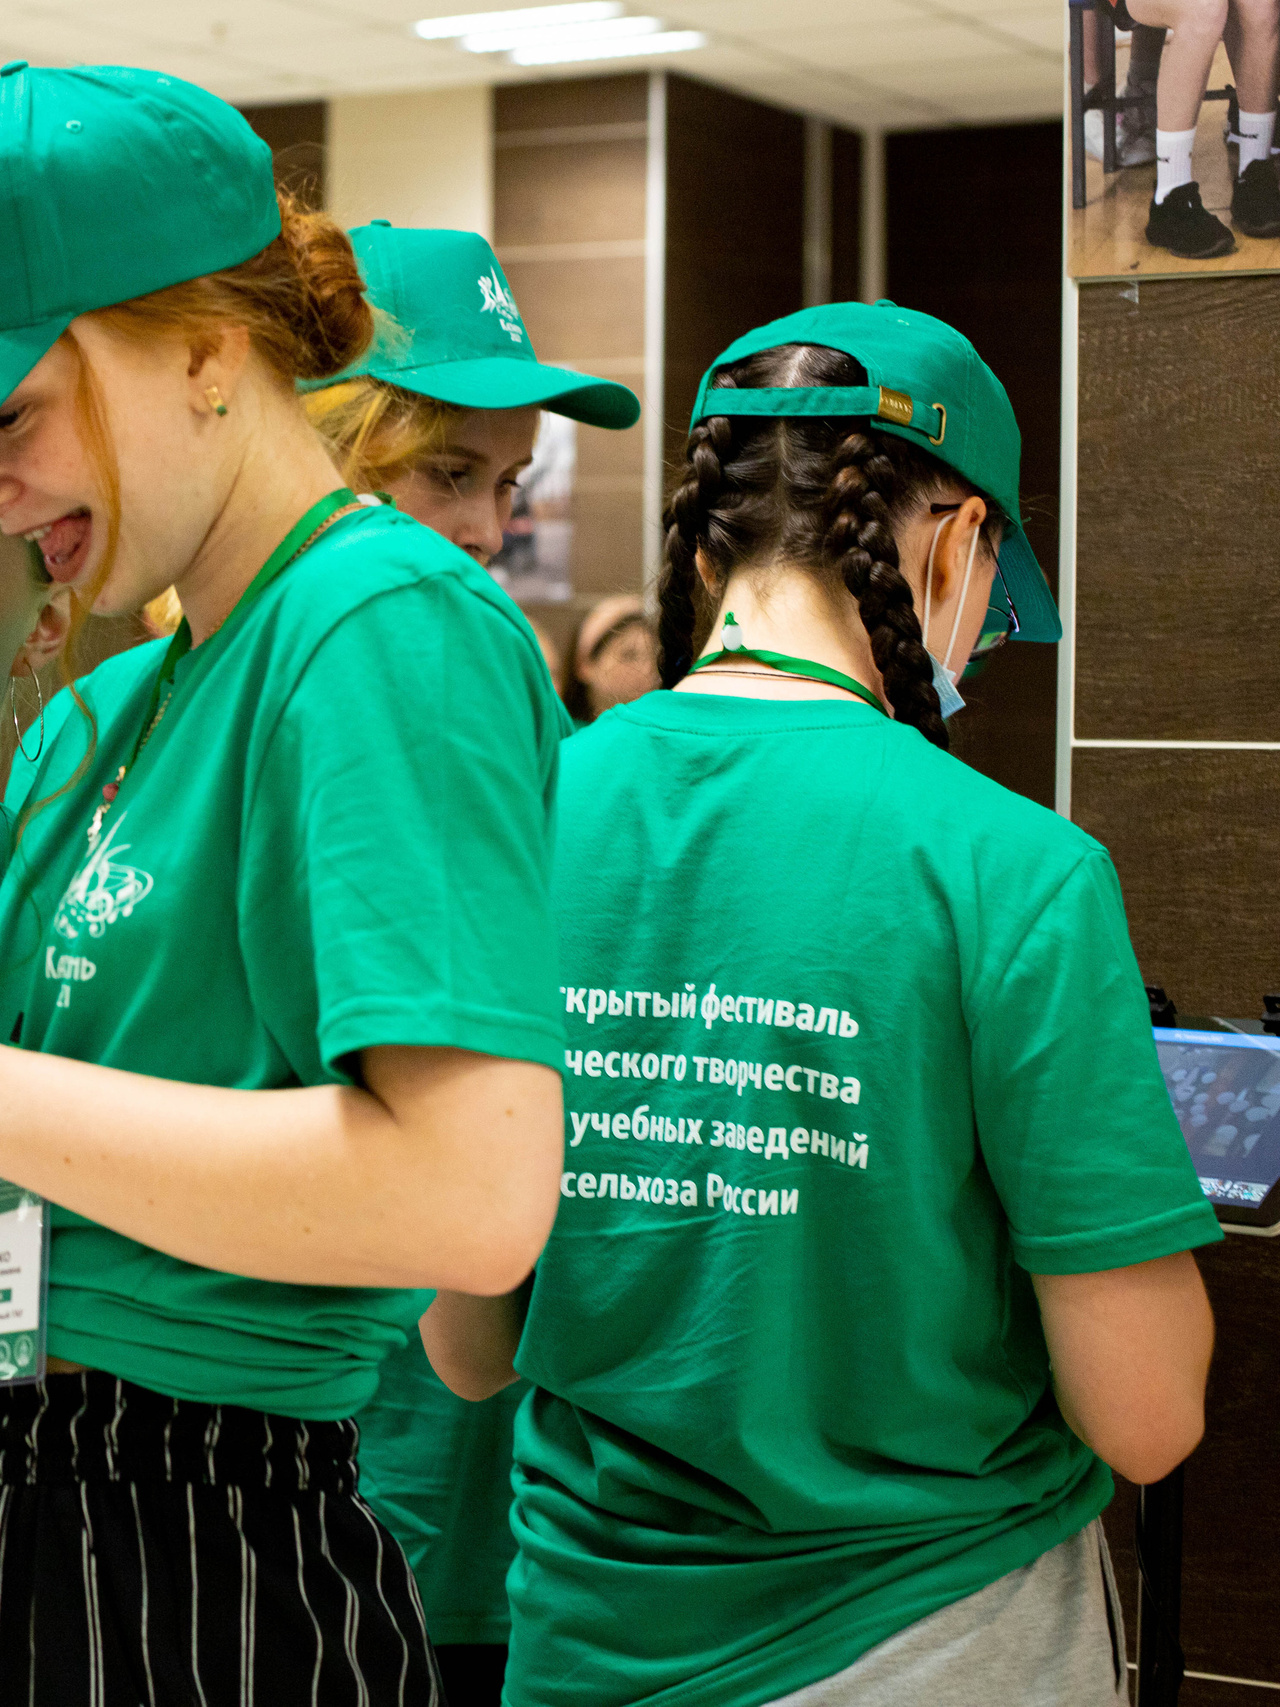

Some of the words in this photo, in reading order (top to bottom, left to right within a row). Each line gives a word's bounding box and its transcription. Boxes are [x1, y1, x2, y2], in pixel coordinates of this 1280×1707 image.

[559, 983, 697, 1025] крытый
[701, 983, 859, 1038] фестиваль
[692, 1055, 861, 1105] творчества
[570, 1104, 703, 1147] учебных
[710, 1120, 869, 1170] заведений
[560, 1171, 698, 1207] сельхоза
[706, 1173, 799, 1216] России
